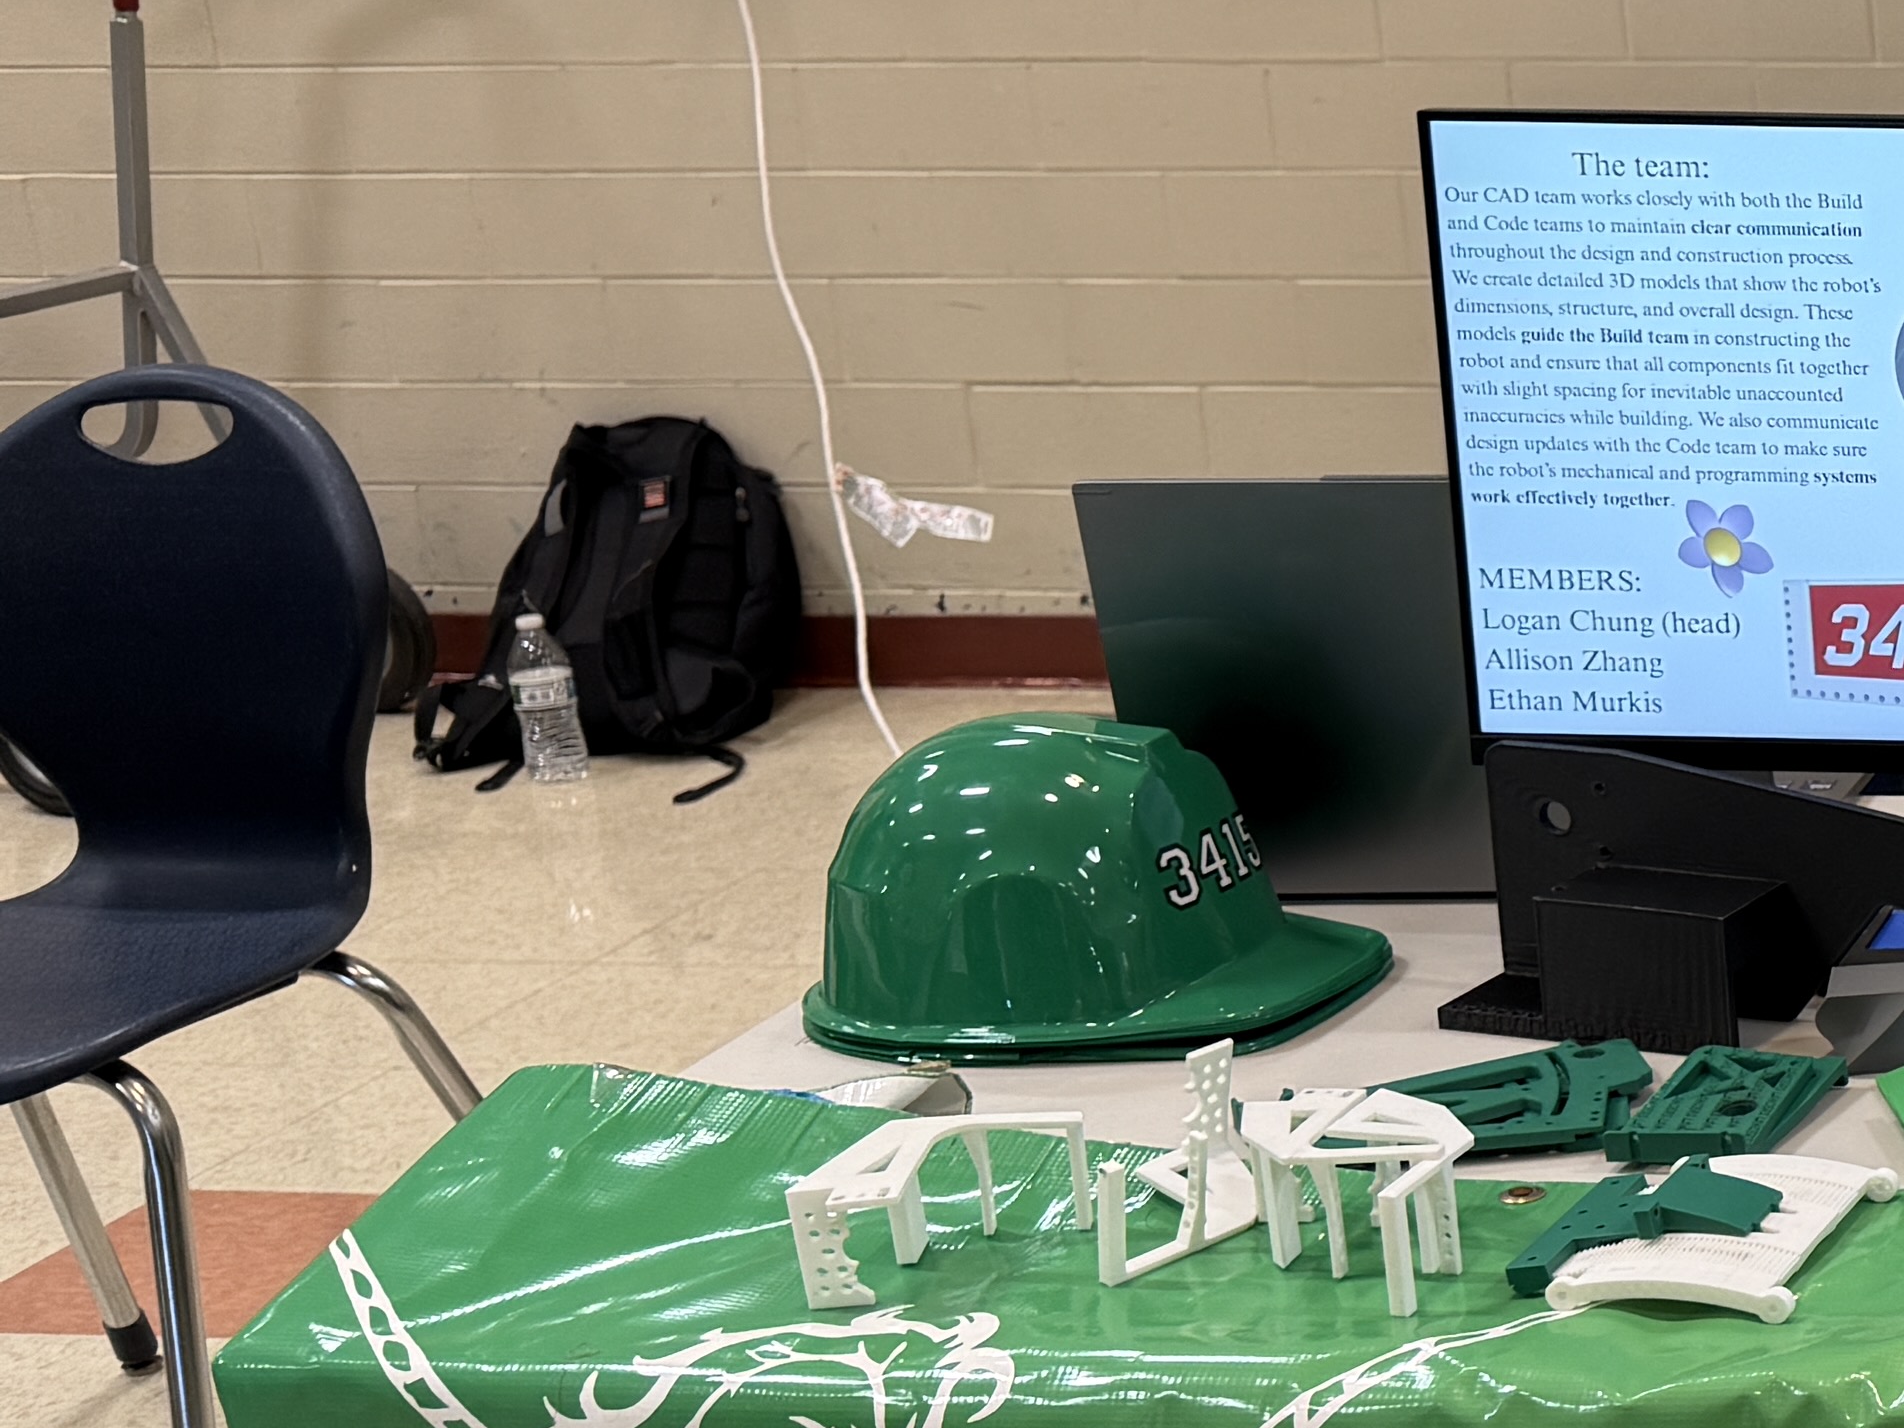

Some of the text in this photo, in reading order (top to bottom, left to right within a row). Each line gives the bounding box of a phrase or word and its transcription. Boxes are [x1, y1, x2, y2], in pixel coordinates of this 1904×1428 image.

[1571, 151, 1710, 179] The team:
[1444, 186, 1863, 211] Our CAD team works closely with both the Build
[1447, 214, 1862, 238] and Code teams to maintain clear communication
[1449, 241, 1545, 263] throughout
[1549, 244, 1577, 260] the
[1580, 244, 1635, 265] design
[1639, 245, 1672, 262] and
[1676, 250, 1784, 264] construction
[1451, 269, 1478, 286] We
[1482, 273, 1533, 287] create
[1537, 271, 1604, 288] detailed
[1609, 272, 1635, 289] 3D
[1640, 273, 1701, 291] models
[1704, 274, 1738, 291] that
[1743, 274, 1787, 292] show
[1791, 276, 1818, 293] the
[1468, 461, 1494, 477] the
[1561, 463, 1654, 481] mechanical
[1659, 465, 1691, 481] and
[1695, 467, 1810, 487] programming
[1813, 470, 1878, 487] systems
[1470, 488, 1675, 509] work effectively together.
[1478, 567, 1642, 593] MEMBERS:
[1482, 607, 1741, 639] Logan Chung (head)
[1485, 647, 1665, 679] Allison Zhang
[1488, 688, 1663, 714] Ethan Murkis
[1157, 812, 1262, 909] 3415
